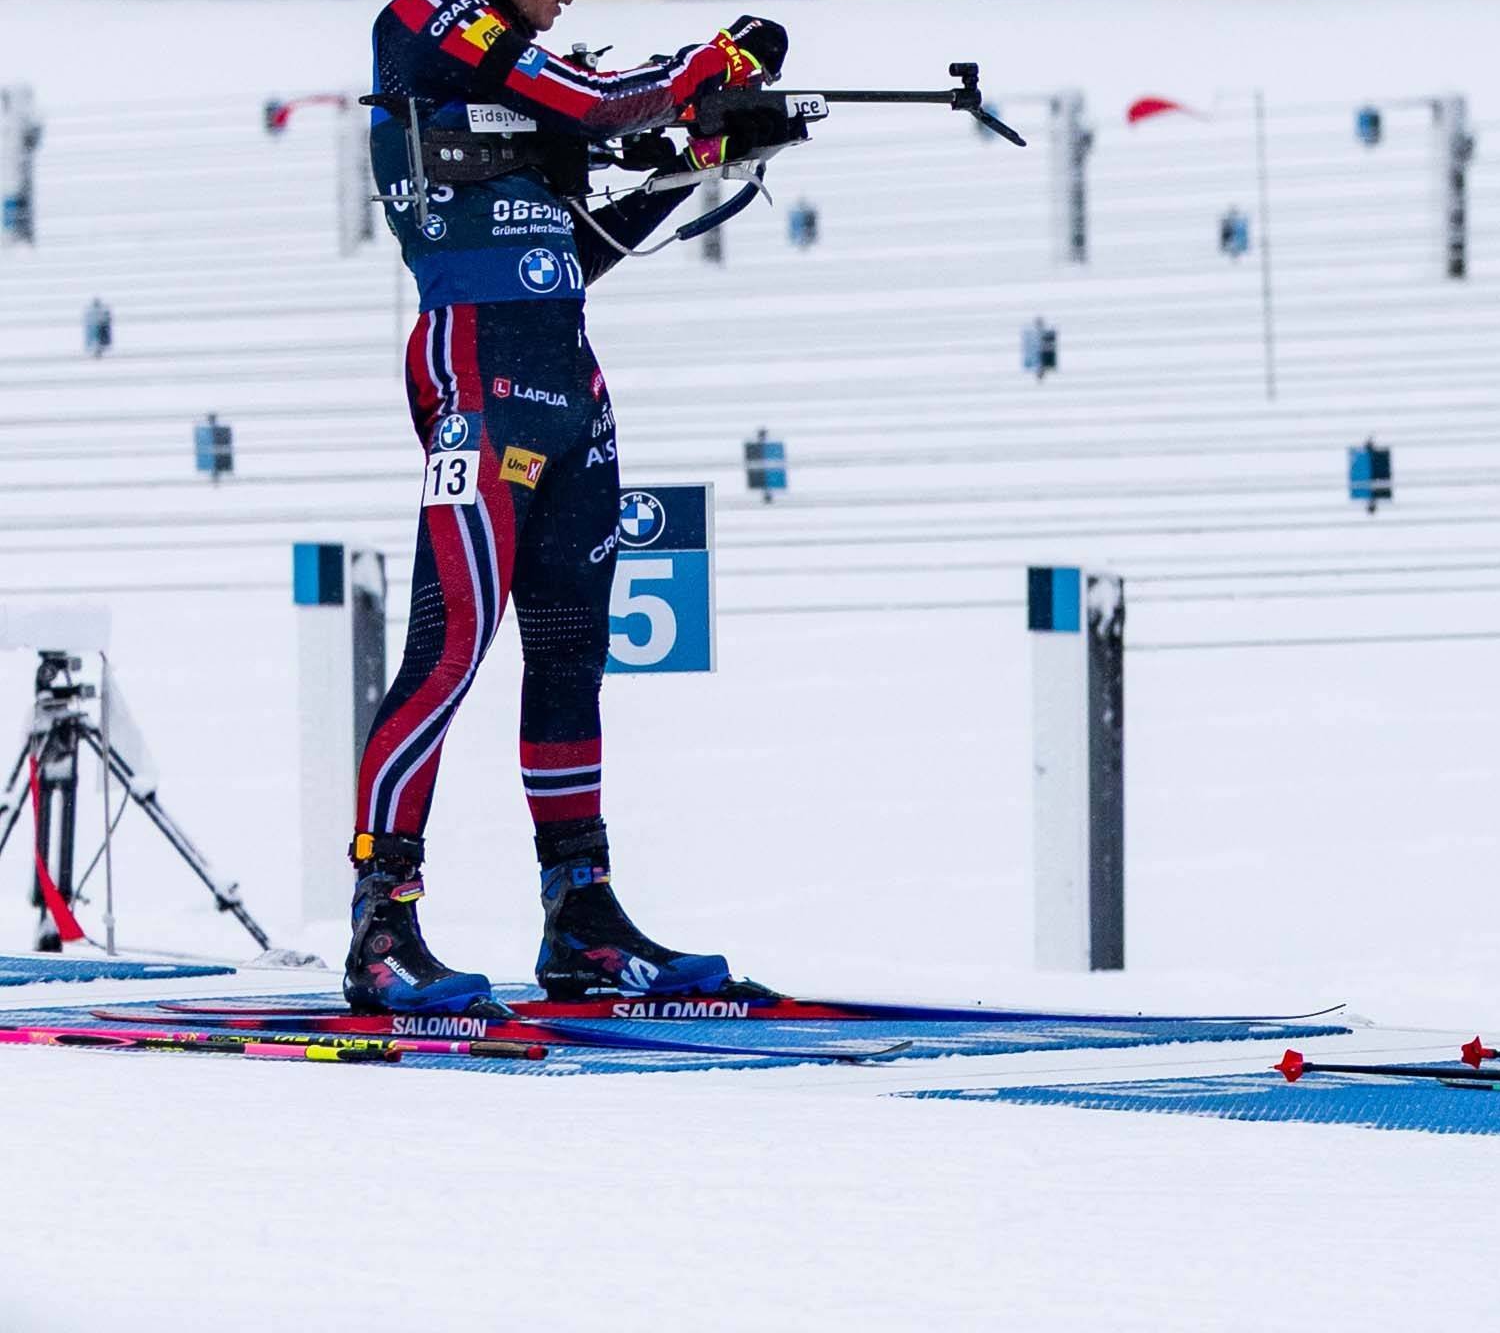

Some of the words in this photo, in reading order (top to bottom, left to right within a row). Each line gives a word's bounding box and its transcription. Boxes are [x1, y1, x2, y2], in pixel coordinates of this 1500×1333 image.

[493, 225, 527, 236] Grünes
[514, 384, 568, 408] LAPUA
[432, 458, 468, 496] 13
[589, 525, 621, 564] CRA
[607, 558, 677, 666] 5
[612, 1001, 749, 1019] SALOMON
[391, 1017, 487, 1037] SALOMON
